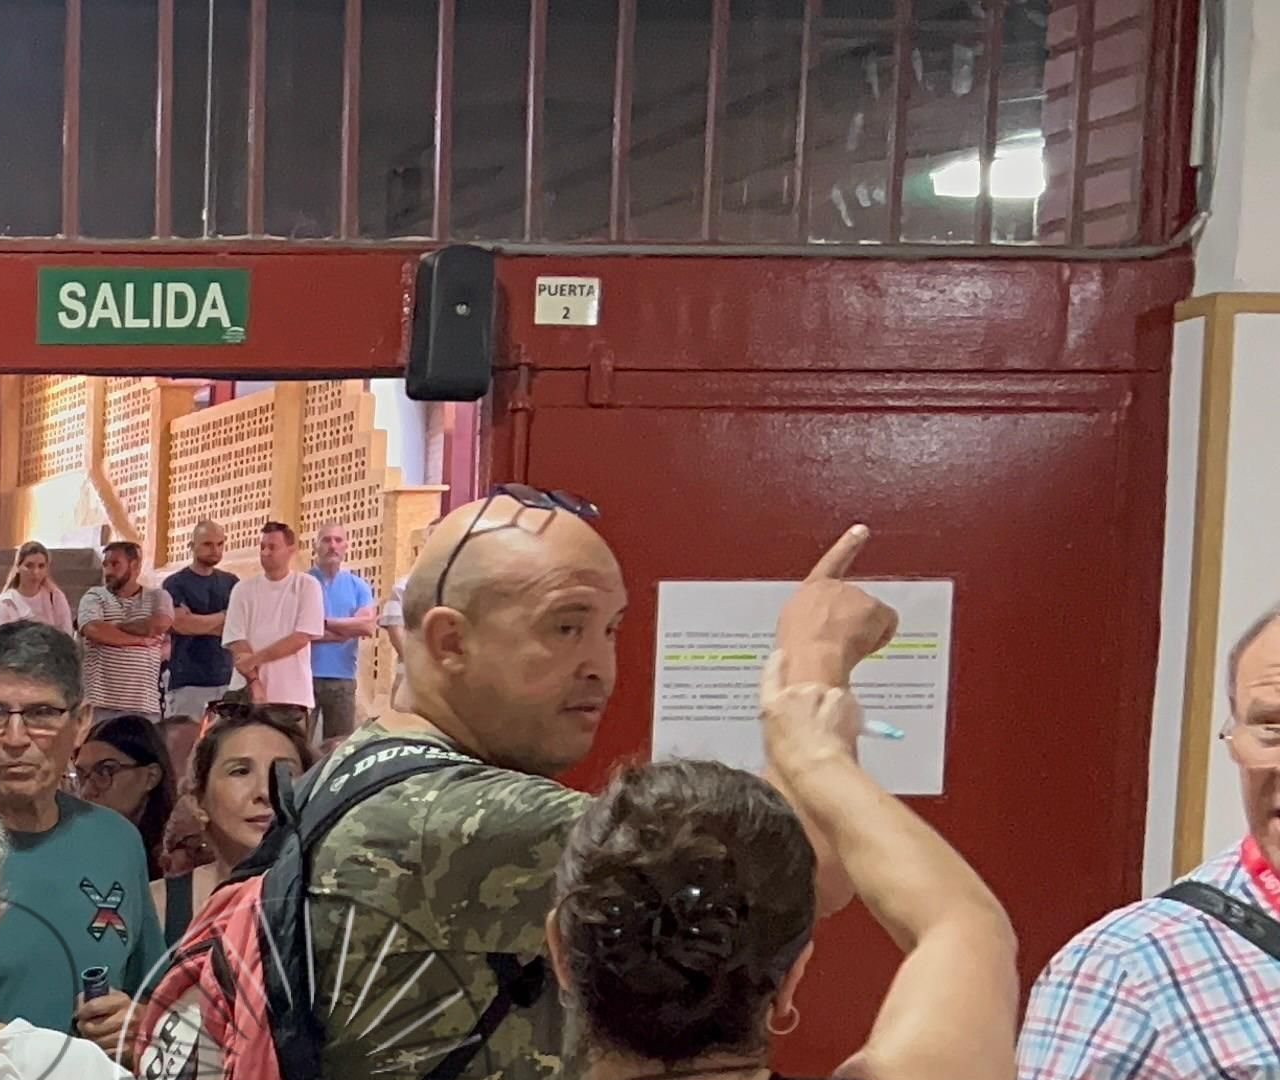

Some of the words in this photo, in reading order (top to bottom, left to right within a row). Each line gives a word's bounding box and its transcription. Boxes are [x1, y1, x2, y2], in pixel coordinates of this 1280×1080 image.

[538, 283, 596, 297] PUERTA
[57, 281, 232, 329] SALIDA
[562, 306, 571, 320] 2
